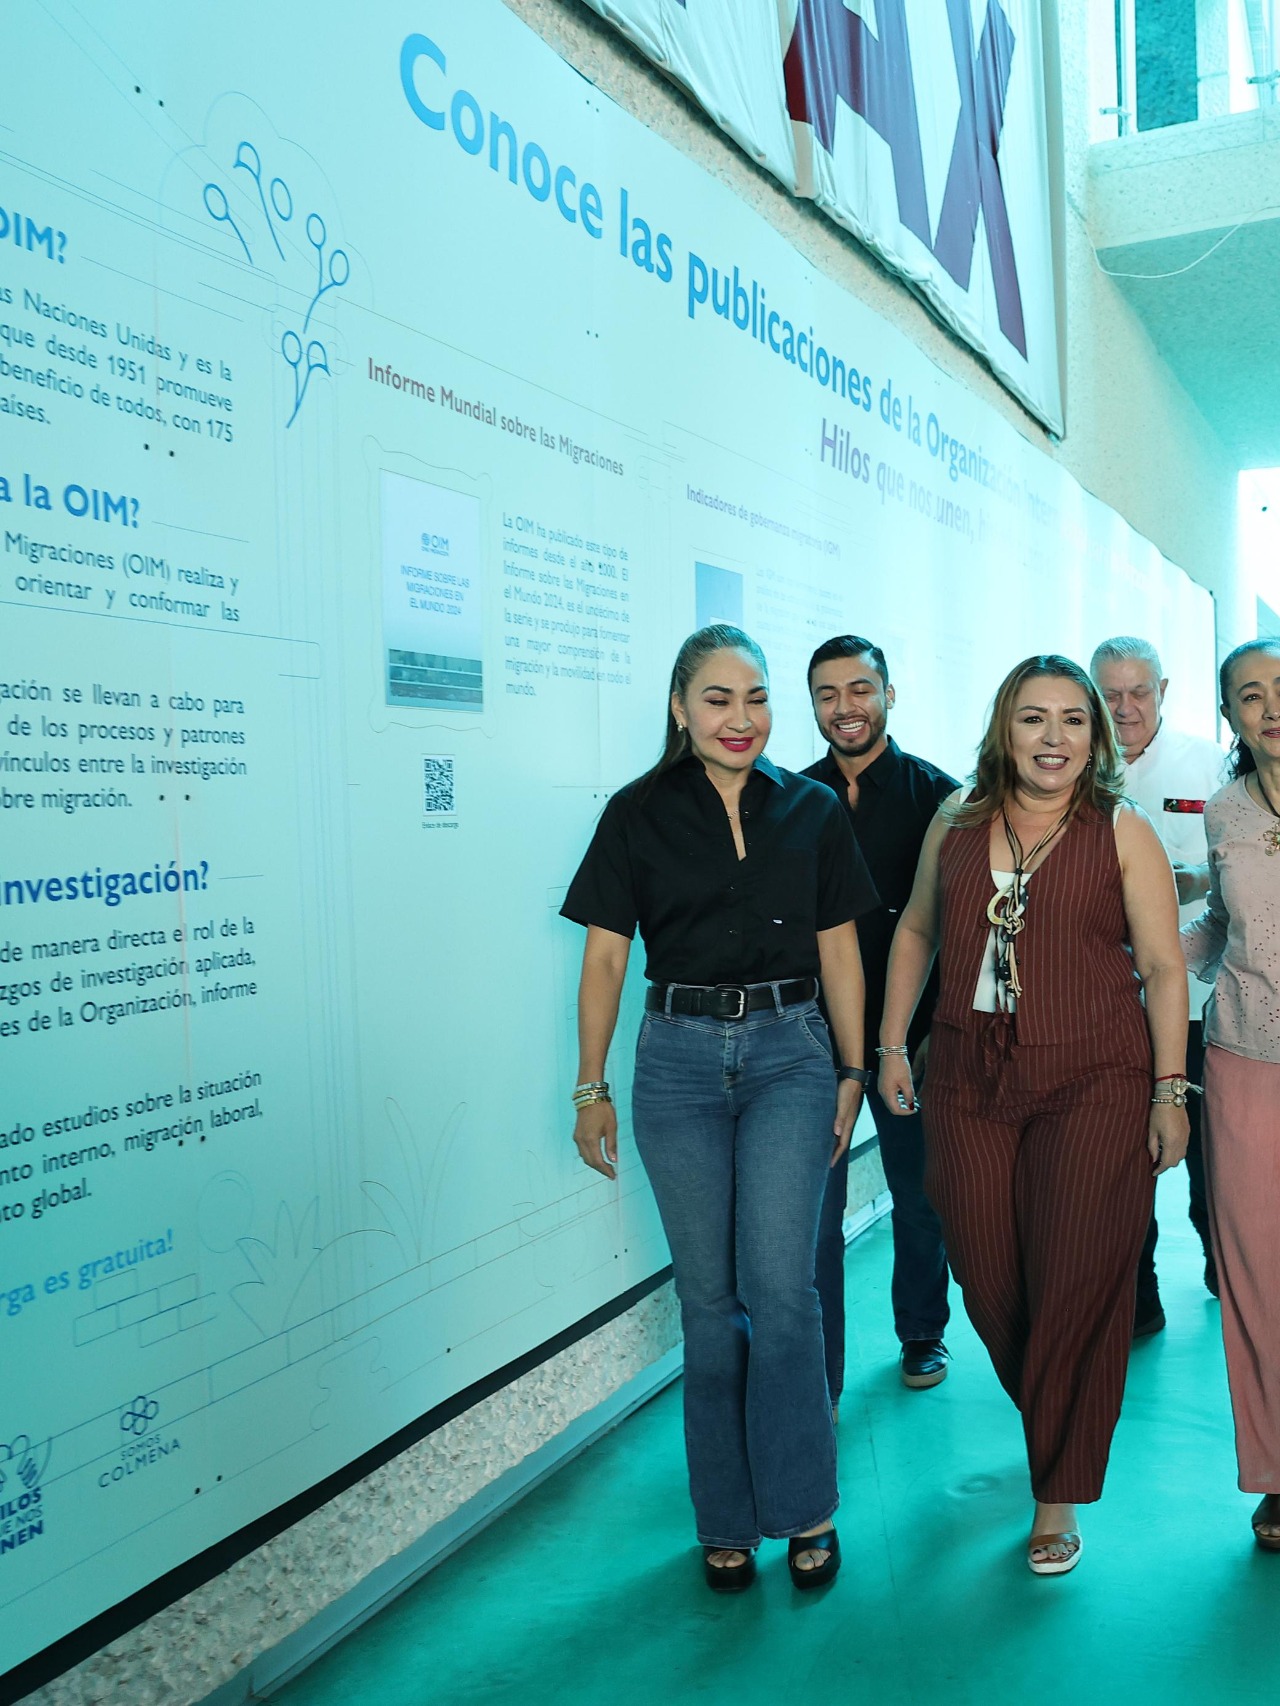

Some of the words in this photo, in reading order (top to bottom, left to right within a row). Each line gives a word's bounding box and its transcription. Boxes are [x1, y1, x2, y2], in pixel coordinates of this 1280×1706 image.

[399, 33, 604, 239] Conoce
[620, 187, 673, 283] las
[688, 251, 872, 413] publicaciones
[880, 378, 902, 432] de
[908, 395, 921, 447] la
[23, 288, 108, 338] Naciones
[116, 322, 172, 361] Unidas
[178, 350, 189, 372] y
[196, 357, 213, 375] es
[219, 360, 233, 382] la
[45, 334, 99, 369] desde
[107, 354, 146, 385] 1951
[157, 376, 233, 412] promueve
[90, 383, 111, 408] de
[116, 395, 168, 427] todos,
[172, 413, 201, 434] con
[206, 418, 234, 443] 175
[367, 356, 436, 403] Informe
[440, 385, 497, 427] Mundial
[500, 415, 537, 442] sobre
[539, 426, 556, 450] las
[559, 434, 624, 477] Migraciones
[24, 472, 52, 511] la
[63, 483, 140, 528] OIM?
[686, 483, 737, 517] Indicadores
[738, 504, 749, 521] de
[820, 417, 871, 485] Hilos
[876, 461, 906, 506] que
[909, 479, 932, 518] nos
[937, 493, 975, 545] unen,
[502, 511, 513, 528] La
[515, 516, 534, 535] OIM
[619, 547, 629, 561] de
[503, 537, 538, 559] informes
[543, 547, 566, 566] desde
[4, 530, 115, 571] Migraciones
[122, 552, 171, 580] (OIM)
[177, 566, 225, 589] realiza
[229, 577, 239, 596] y
[503, 559, 535, 581] Informe
[538, 570, 560, 587] sobre
[576, 577, 618, 600] Migraciones
[15, 574, 93, 601] orientar
[105, 588, 116, 610] y
[128, 591, 211, 618] conformar
[220, 600, 241, 622] las
[513, 586, 542, 605] Mundo
[620, 609, 630, 623] de
[504, 607, 512, 623] la
[513, 612, 533, 627] serie
[541, 618, 550, 630] se
[551, 619, 581, 638] produjo
[582, 625, 598, 640] para
[504, 635, 520, 648] una
[526, 639, 552, 655] mayor
[62, 687, 83, 705] se
[92, 683, 141, 708] llevan
[150, 693, 160, 708] a
[169, 691, 205, 712] cabo
[213, 698, 245, 718] para
[8, 714, 32, 737] de
[41, 715, 69, 738] los
[78, 723, 156, 745] procesos
[163, 727, 174, 748] y
[181, 728, 246, 748] patrones
[79, 757, 125, 774] entre
[131, 753, 145, 775] la
[151, 755, 247, 781] investigación
[41, 787, 133, 815] migración.
[31, 936, 101, 960] manera
[107, 928, 167, 950] directa
[172, 922, 188, 942] el
[193, 919, 214, 942] rol
[220, 917, 238, 937] de
[243, 916, 255, 934] la
[49, 971, 73, 993] de
[81, 956, 189, 987] investigación
[195, 947, 256, 977] aplicada,
[28, 1009, 52, 1032] de
[58, 1006, 74, 1027] la
[80, 988, 198, 1025] Organización,
[201, 980, 258, 1005] informe
[42, 1105, 120, 1137] estudios
[125, 1092, 174, 1117] sobre
[179, 1084, 192, 1105] la
[197, 1069, 262, 1101] situación
[42, 1141, 116, 1174] interno,
[123, 1115, 204, 1152] migración
[210, 1097, 263, 1130] laboral,
[31, 1177, 92, 1220] global.
[43, 1269, 71, 1294] es
[77, 1228, 174, 1290] gratuita!
[98, 1437, 181, 1488] COLMENA
[120, 1433, 161, 1461] SOMOS
